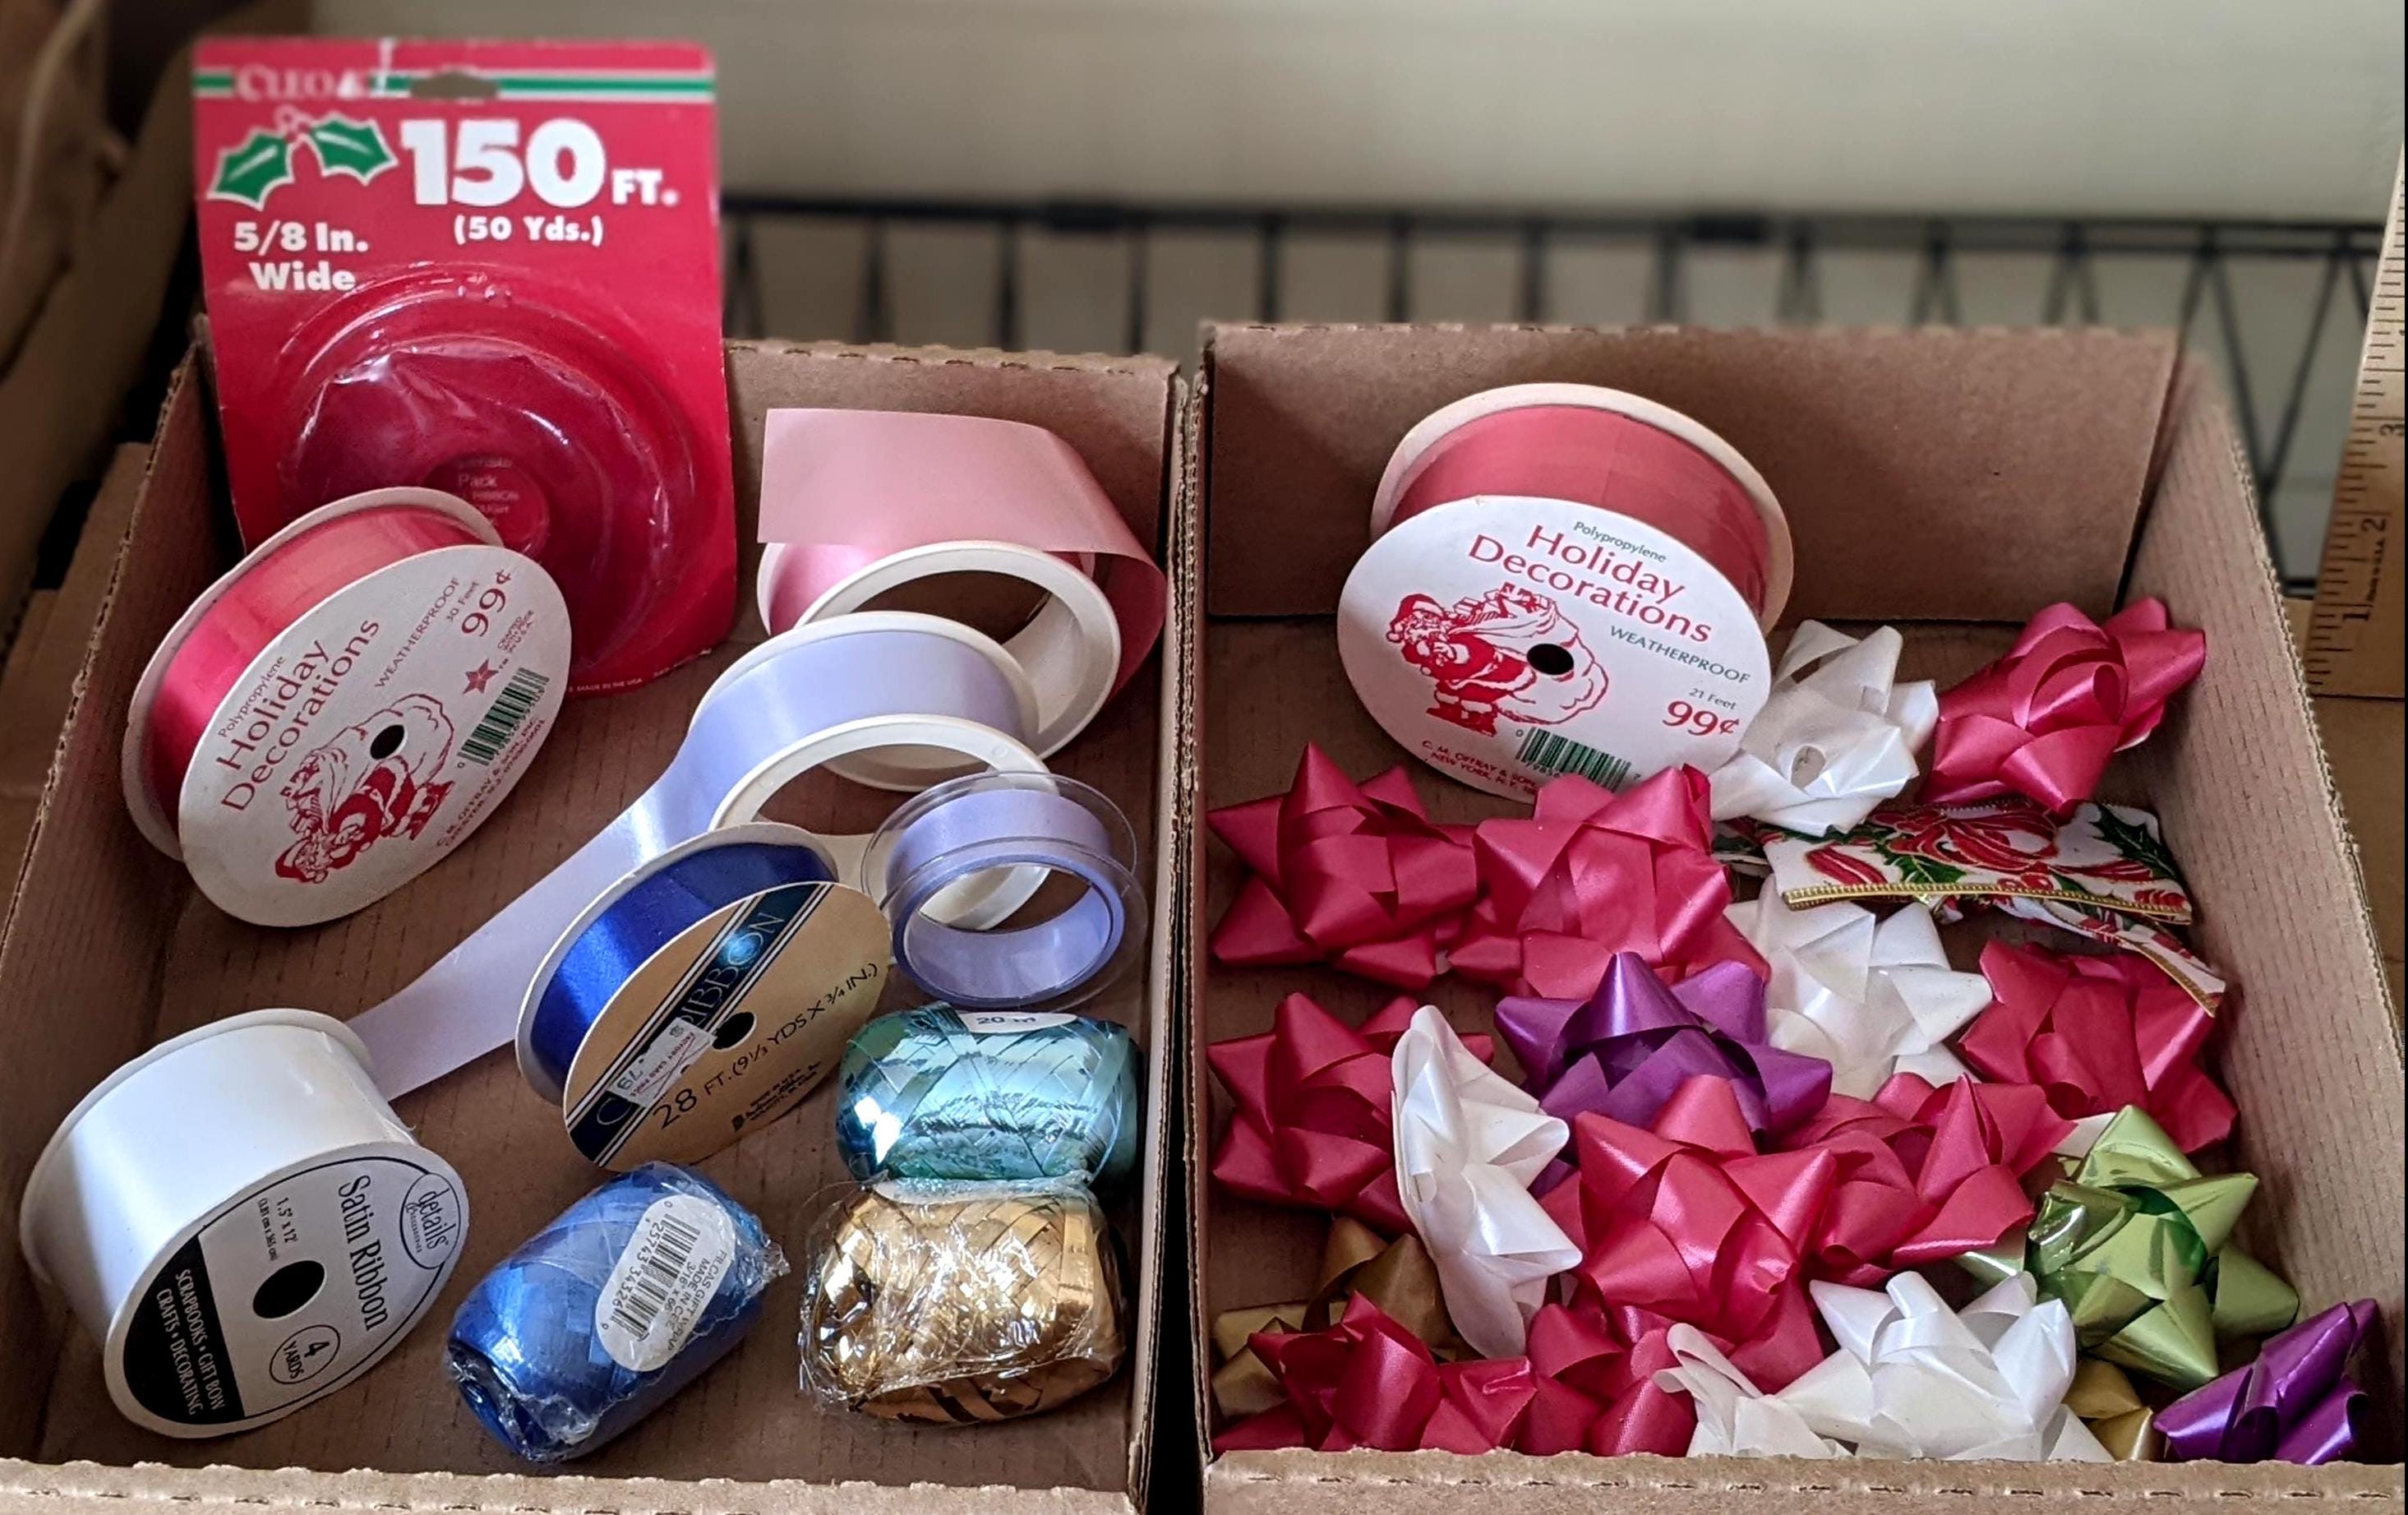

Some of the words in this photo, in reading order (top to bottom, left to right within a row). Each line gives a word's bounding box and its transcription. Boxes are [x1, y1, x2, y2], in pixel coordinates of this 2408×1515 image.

[400, 118, 607, 208] 150
[612, 169, 680, 207] FT.
[234, 221, 307, 256] 5/8
[316, 223, 370, 254] In.
[454, 215, 513, 247] (50
[524, 215, 605, 247] Yds.)
[248, 262, 357, 292] Wide
[1573, 521, 1667, 564] Polypropylene
[2360, 518, 2387, 532] 2
[1526, 524, 1686, 604] Holiday
[458, 581, 480, 606] Feet
[461, 569, 512, 637] 99¢
[1468, 533, 1713, 643] Decorations
[375, 577, 460, 688] WEATHERPROOF
[2342, 612, 2370, 621] 1
[1610, 626, 1751, 684] WEATHERPROOF
[216, 640, 330, 770] Holiday
[218, 656, 286, 738] Polypropylene
[221, 620, 380, 811] Decorations
[1662, 700, 1741, 737] 99¢
[1689, 687, 1705, 699] 21
[1707, 693, 1737, 711] Feet
[976, 1015, 1005, 1024] 20
[653, 1088, 698, 1130] 28
[704, 1071, 732, 1096] FT.
[767, 1014, 807, 1046] YDS
[338, 1175, 374, 1245] Satin
[418, 1187, 456, 1249] details
[637, 1222, 664, 1265] 25743
[349, 1238, 390, 1332] Ribbon
[611, 1266, 642, 1309] 34326
[687, 1258, 711, 1291] MADE
[175, 1269, 208, 1346] SCRAPBOOKS
[680, 1291, 692, 1305] IN
[687, 1289, 706, 1317] GIFT
[156, 1288, 181, 1333] CRAFTS
[170, 1338, 204, 1416] DECORATING
[198, 1352, 217, 1381] GIFT
[284, 1341, 305, 1379] YARDS
[304, 1341, 330, 1359] 4
[206, 1379, 226, 1410] BOW
